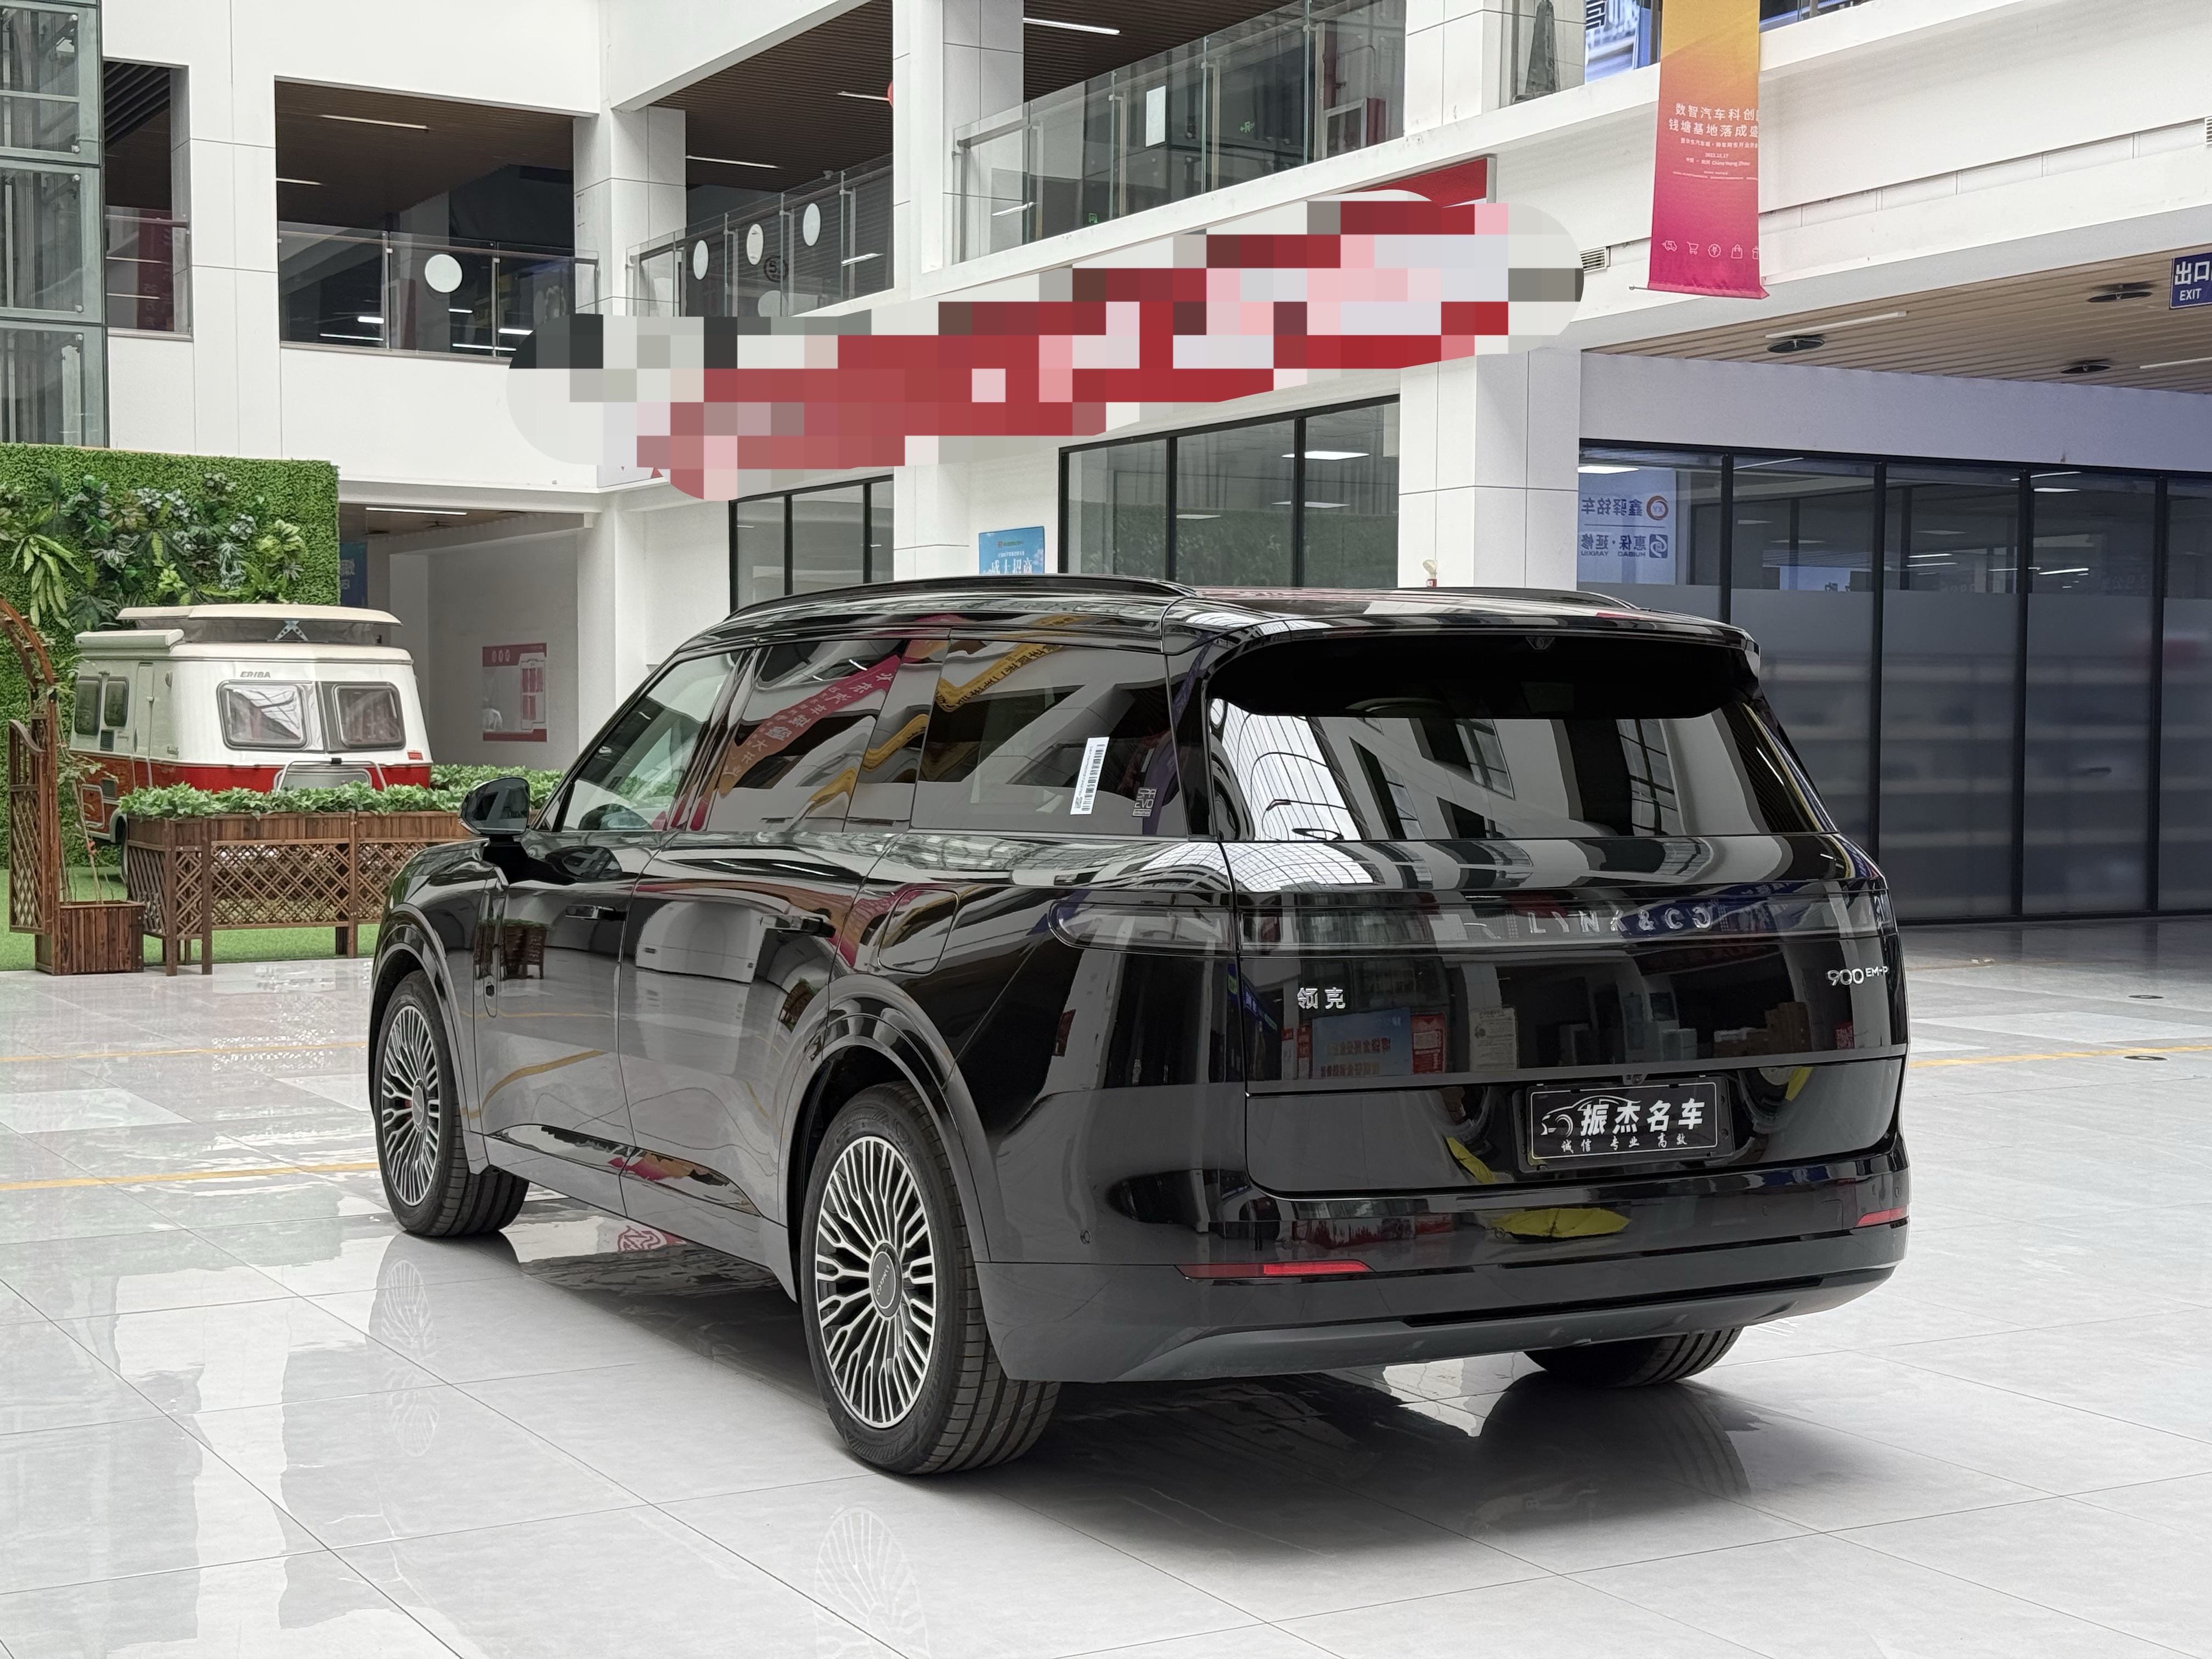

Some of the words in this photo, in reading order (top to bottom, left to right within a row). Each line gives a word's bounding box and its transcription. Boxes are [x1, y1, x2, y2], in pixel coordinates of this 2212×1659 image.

[1675, 103, 1759, 121] 数智汽车科创
[2174, 261, 2210, 286] 出口
[2179, 287, 2202, 301] EXIT
[1827, 969, 1864, 986] 900
[1865, 966, 1888, 978] EM-P
[1297, 987, 1346, 1009] 领克
[1579, 1097, 1705, 1137] 振杰名车
[1561, 1139, 1593, 1154] 诚信
[1609, 1136, 1640, 1151] 专业
[1657, 1132, 1688, 1149] 高效
